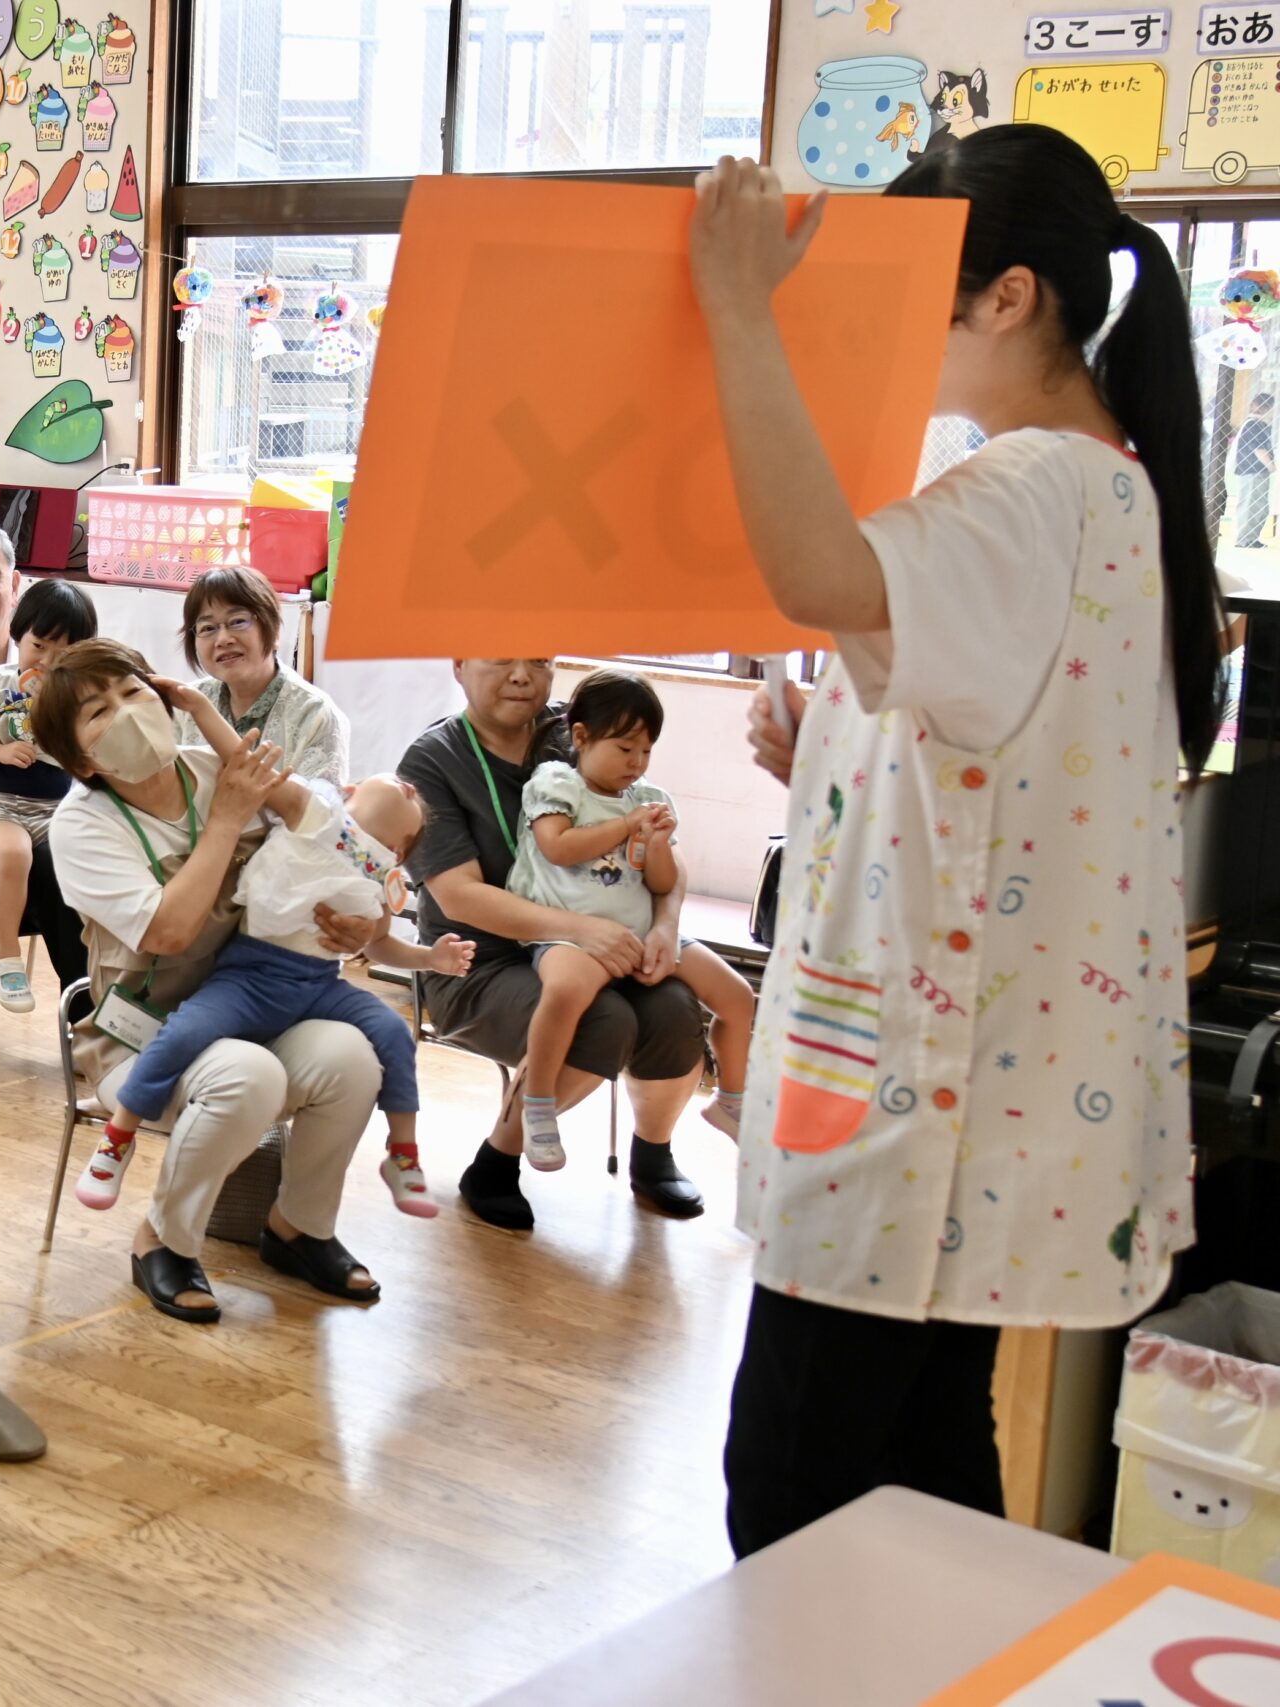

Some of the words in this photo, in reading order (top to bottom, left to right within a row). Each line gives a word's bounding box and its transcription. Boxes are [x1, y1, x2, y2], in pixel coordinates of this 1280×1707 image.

[1033, 14, 1161, 51] 3こーす
[1205, 12, 1275, 46] おあ
[71, 55, 85, 65] もり
[108, 54, 129, 63] つかだ
[106, 64, 128, 74] こなつ
[1046, 78, 1092, 94] おがわ
[1098, 76, 1142, 93] せいた
[6, 80, 28, 103] 10
[85, 122, 110, 131] かきぬま
[87, 132, 107, 141] かんな
[81, 236, 92, 258] 1
[46, 269, 65, 278] かめい
[48, 279, 62, 288] ゆの
[4, 320, 17, 340] 2
[75, 318, 90, 340] 3
[110, 351, 130, 360] てつか
[37, 359, 56, 367] かんた
[109, 361, 129, 371] ことね
